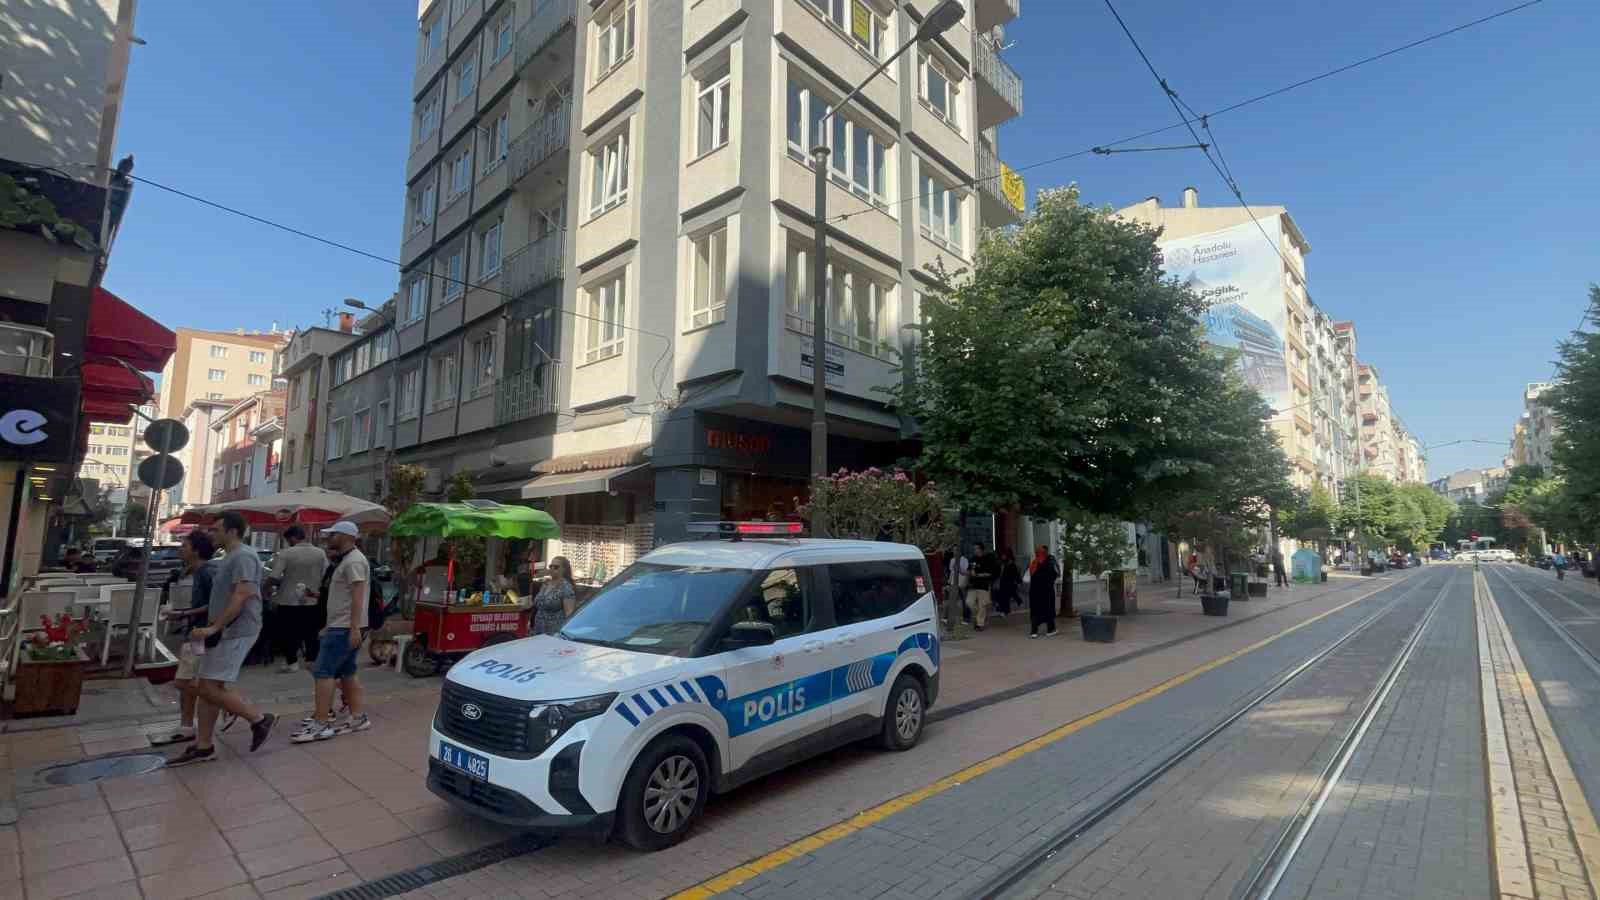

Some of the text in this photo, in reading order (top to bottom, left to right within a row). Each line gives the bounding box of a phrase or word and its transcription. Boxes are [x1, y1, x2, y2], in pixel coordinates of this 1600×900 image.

[470, 658, 546, 684] POLİS
[744, 682, 806, 727] POLİS
[457, 752, 462, 768] A
